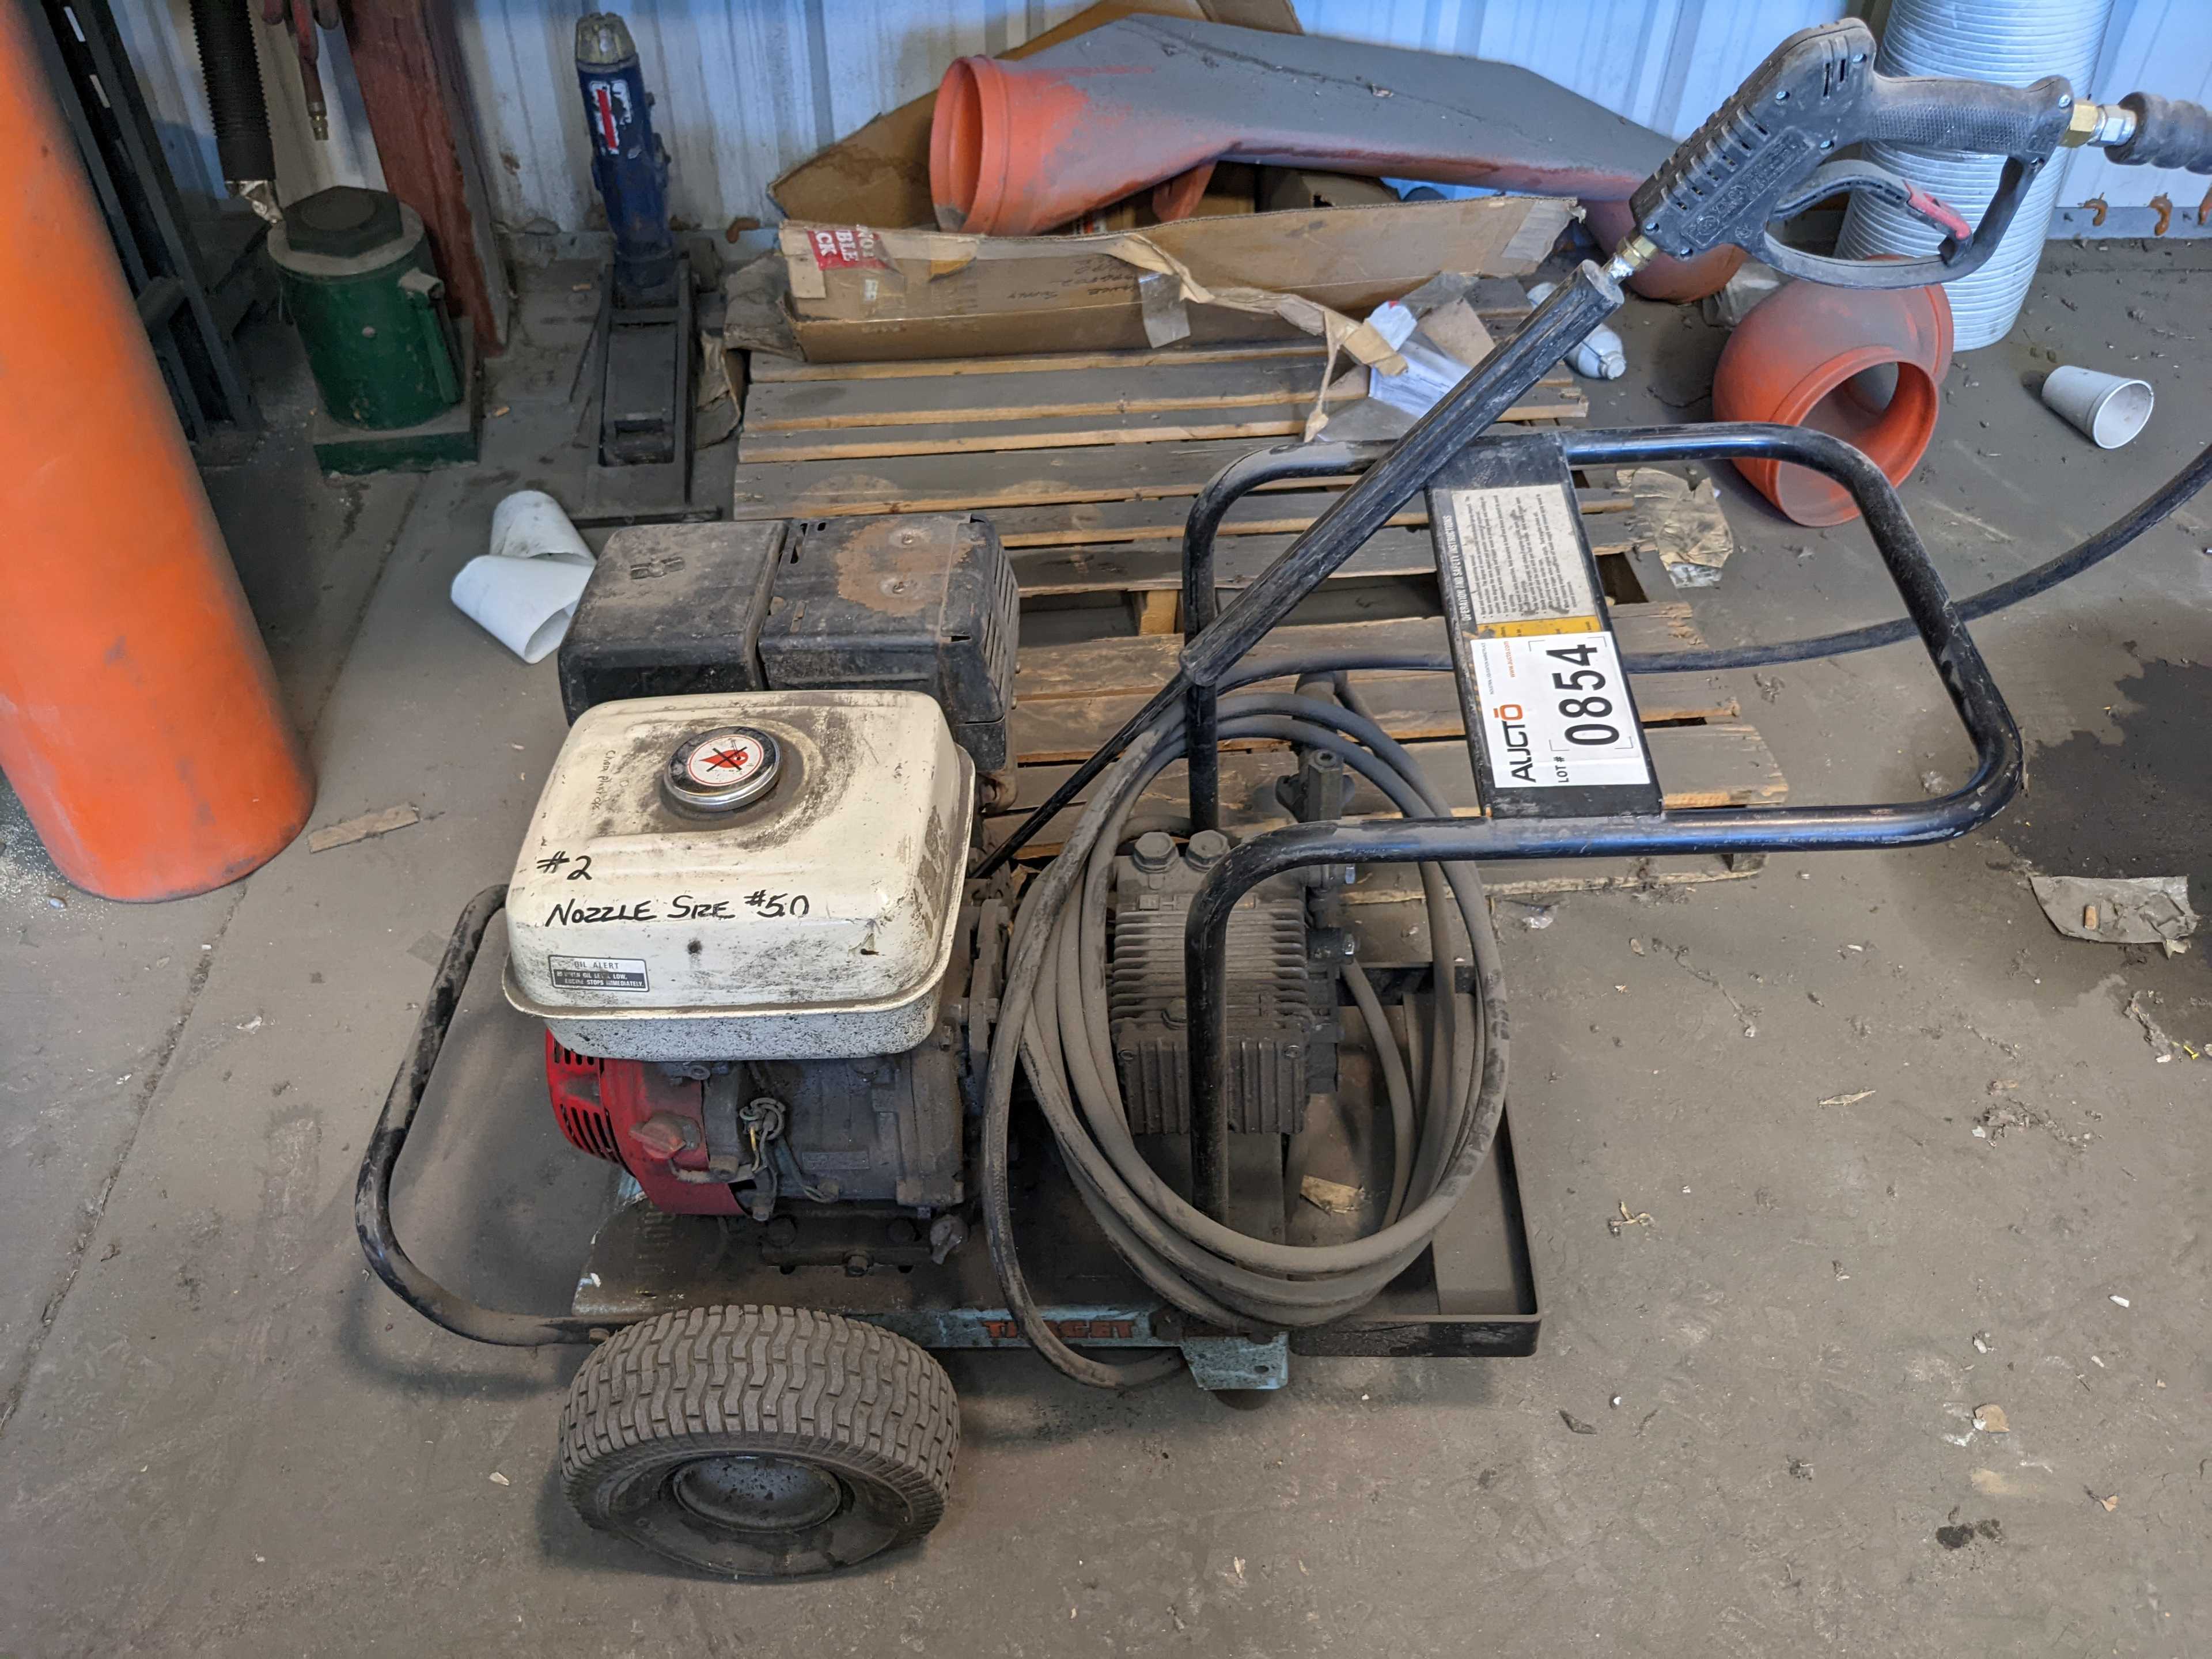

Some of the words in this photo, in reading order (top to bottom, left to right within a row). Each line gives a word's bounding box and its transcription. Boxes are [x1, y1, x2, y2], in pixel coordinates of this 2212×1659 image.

[1442, 516, 1457, 552] INSTRUCTIONS
[1451, 556, 1462, 575] SAFETY
[1455, 577, 1465, 588] AND
[1459, 589, 1471, 620] OPERATION
[1546, 644, 1619, 745] 0854
[1555, 765, 1569, 783] LOT
[537, 850, 592, 881] #2
[593, 961, 619, 969] ALERT
